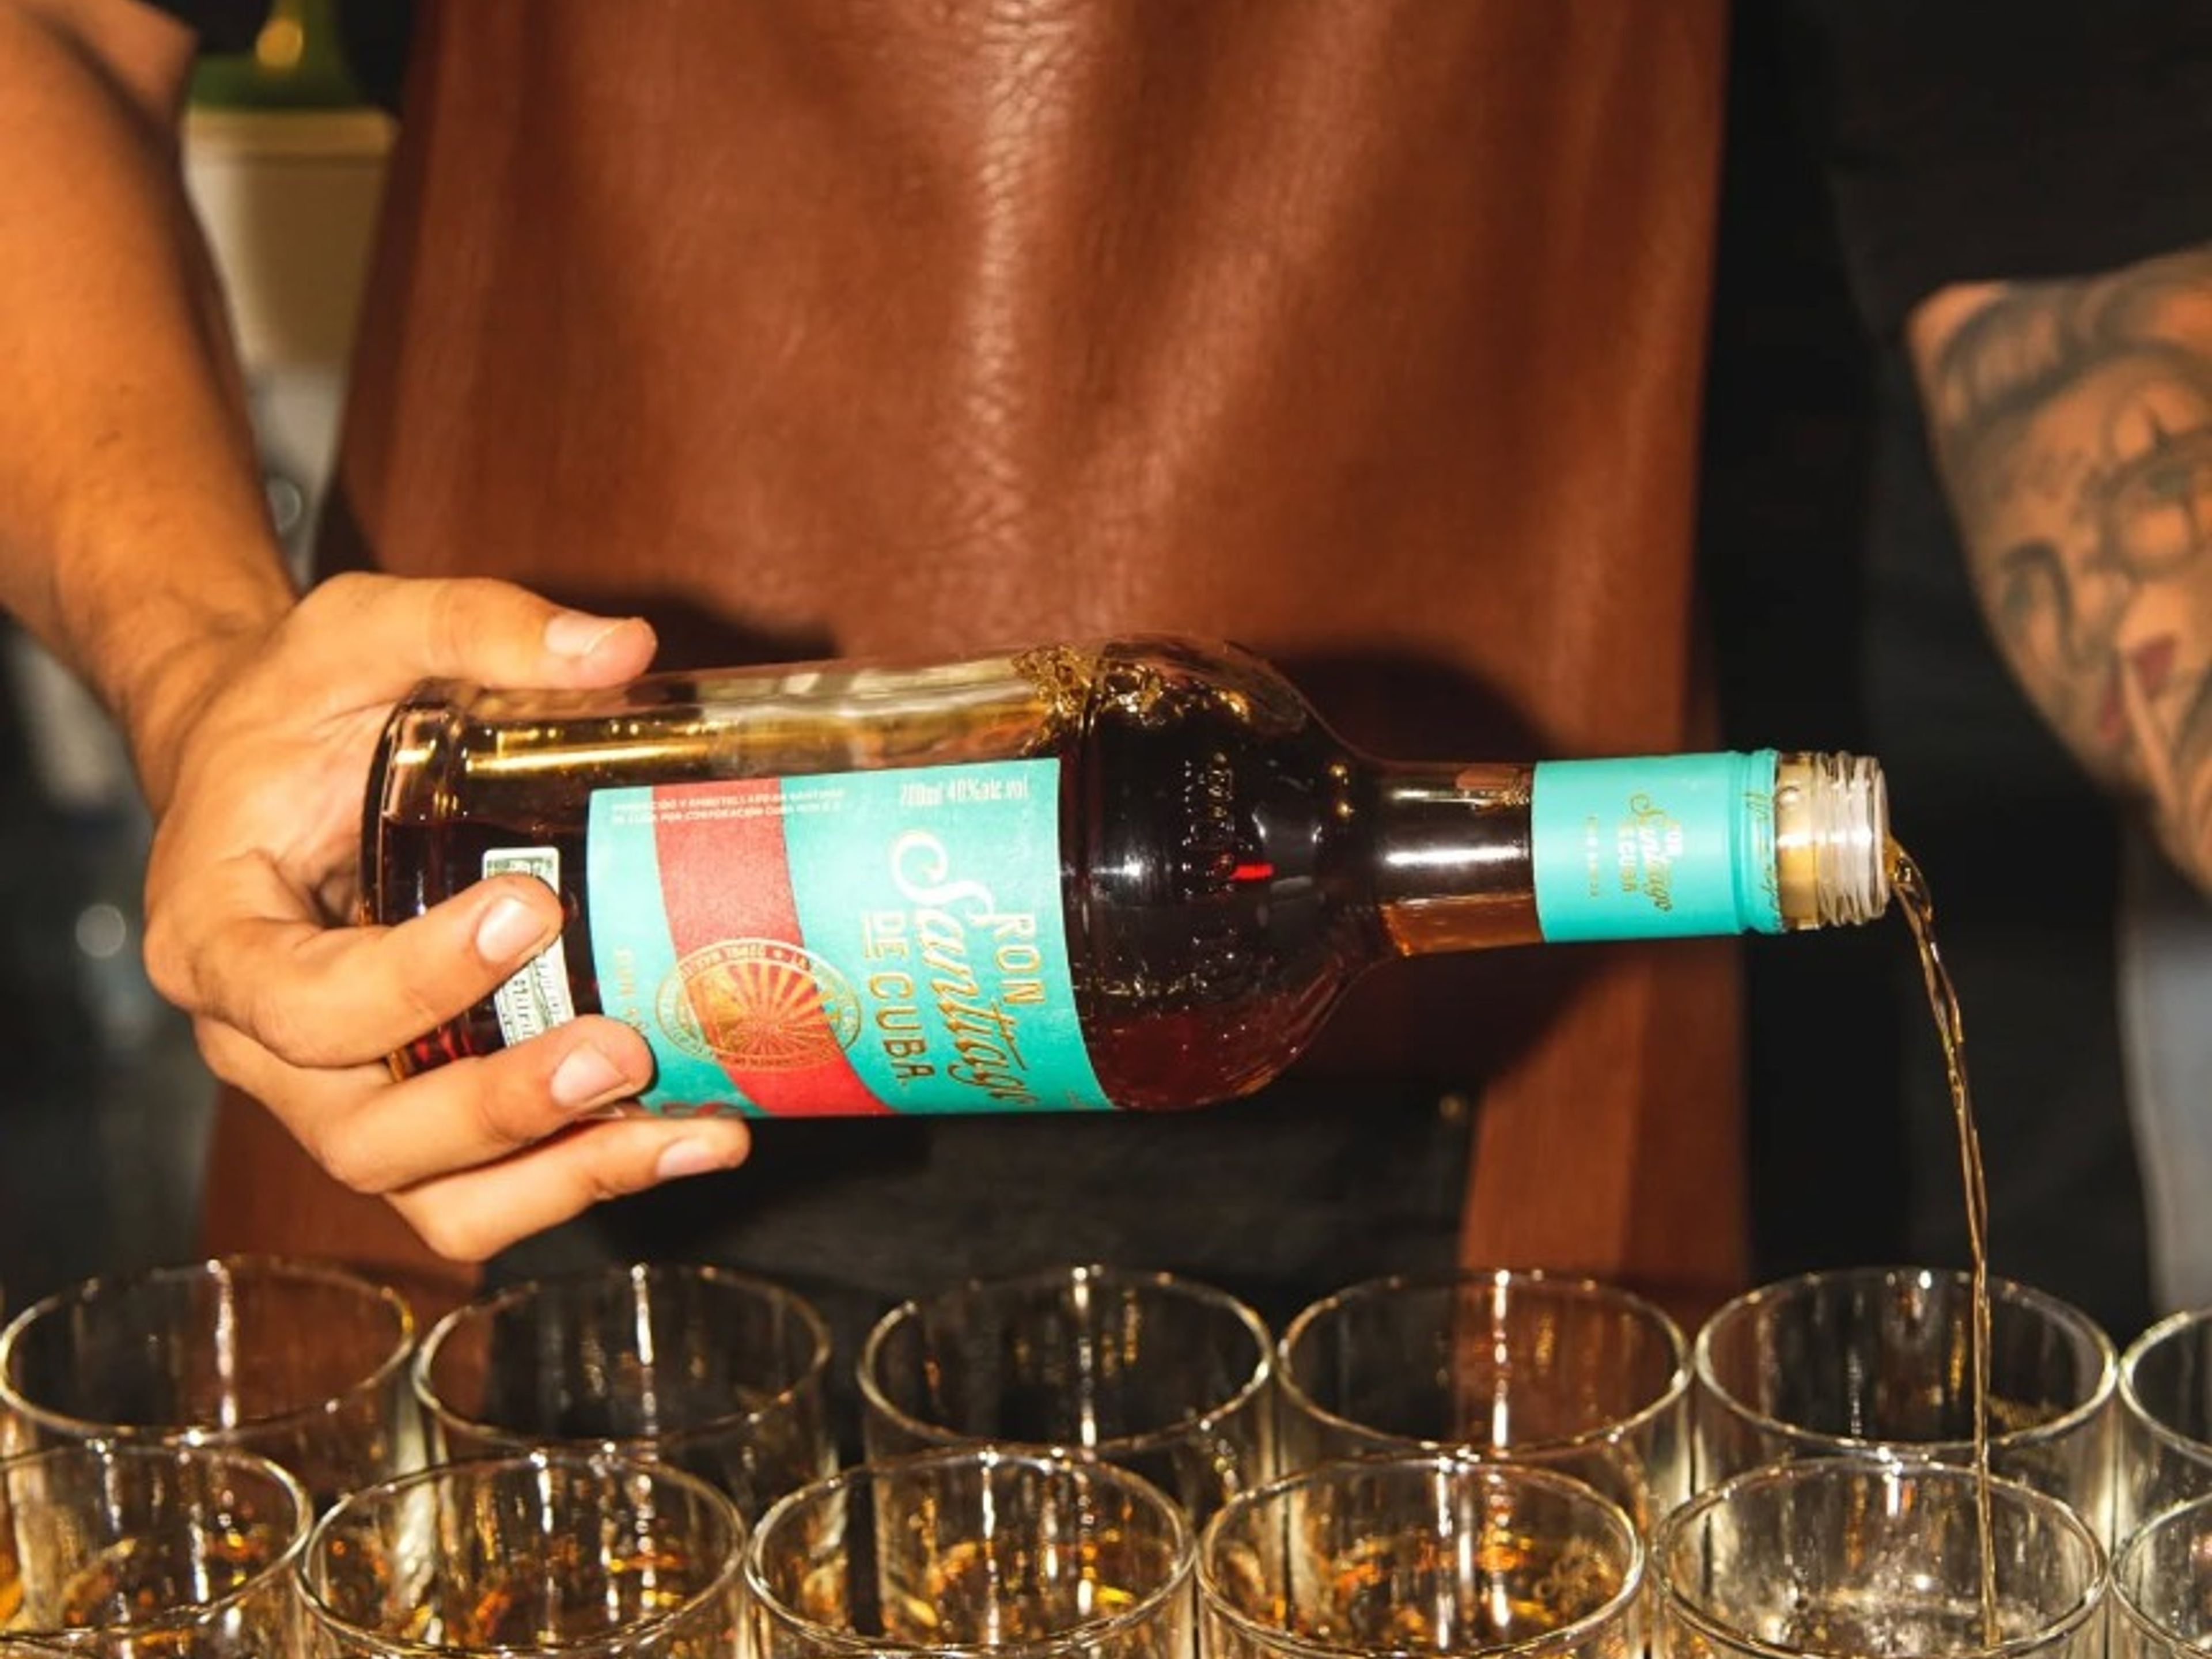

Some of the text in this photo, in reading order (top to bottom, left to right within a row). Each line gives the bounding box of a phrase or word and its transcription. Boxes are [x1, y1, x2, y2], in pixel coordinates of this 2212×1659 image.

[868, 910, 935, 1080] DE CUBA
[992, 912, 1046, 1005] RON
